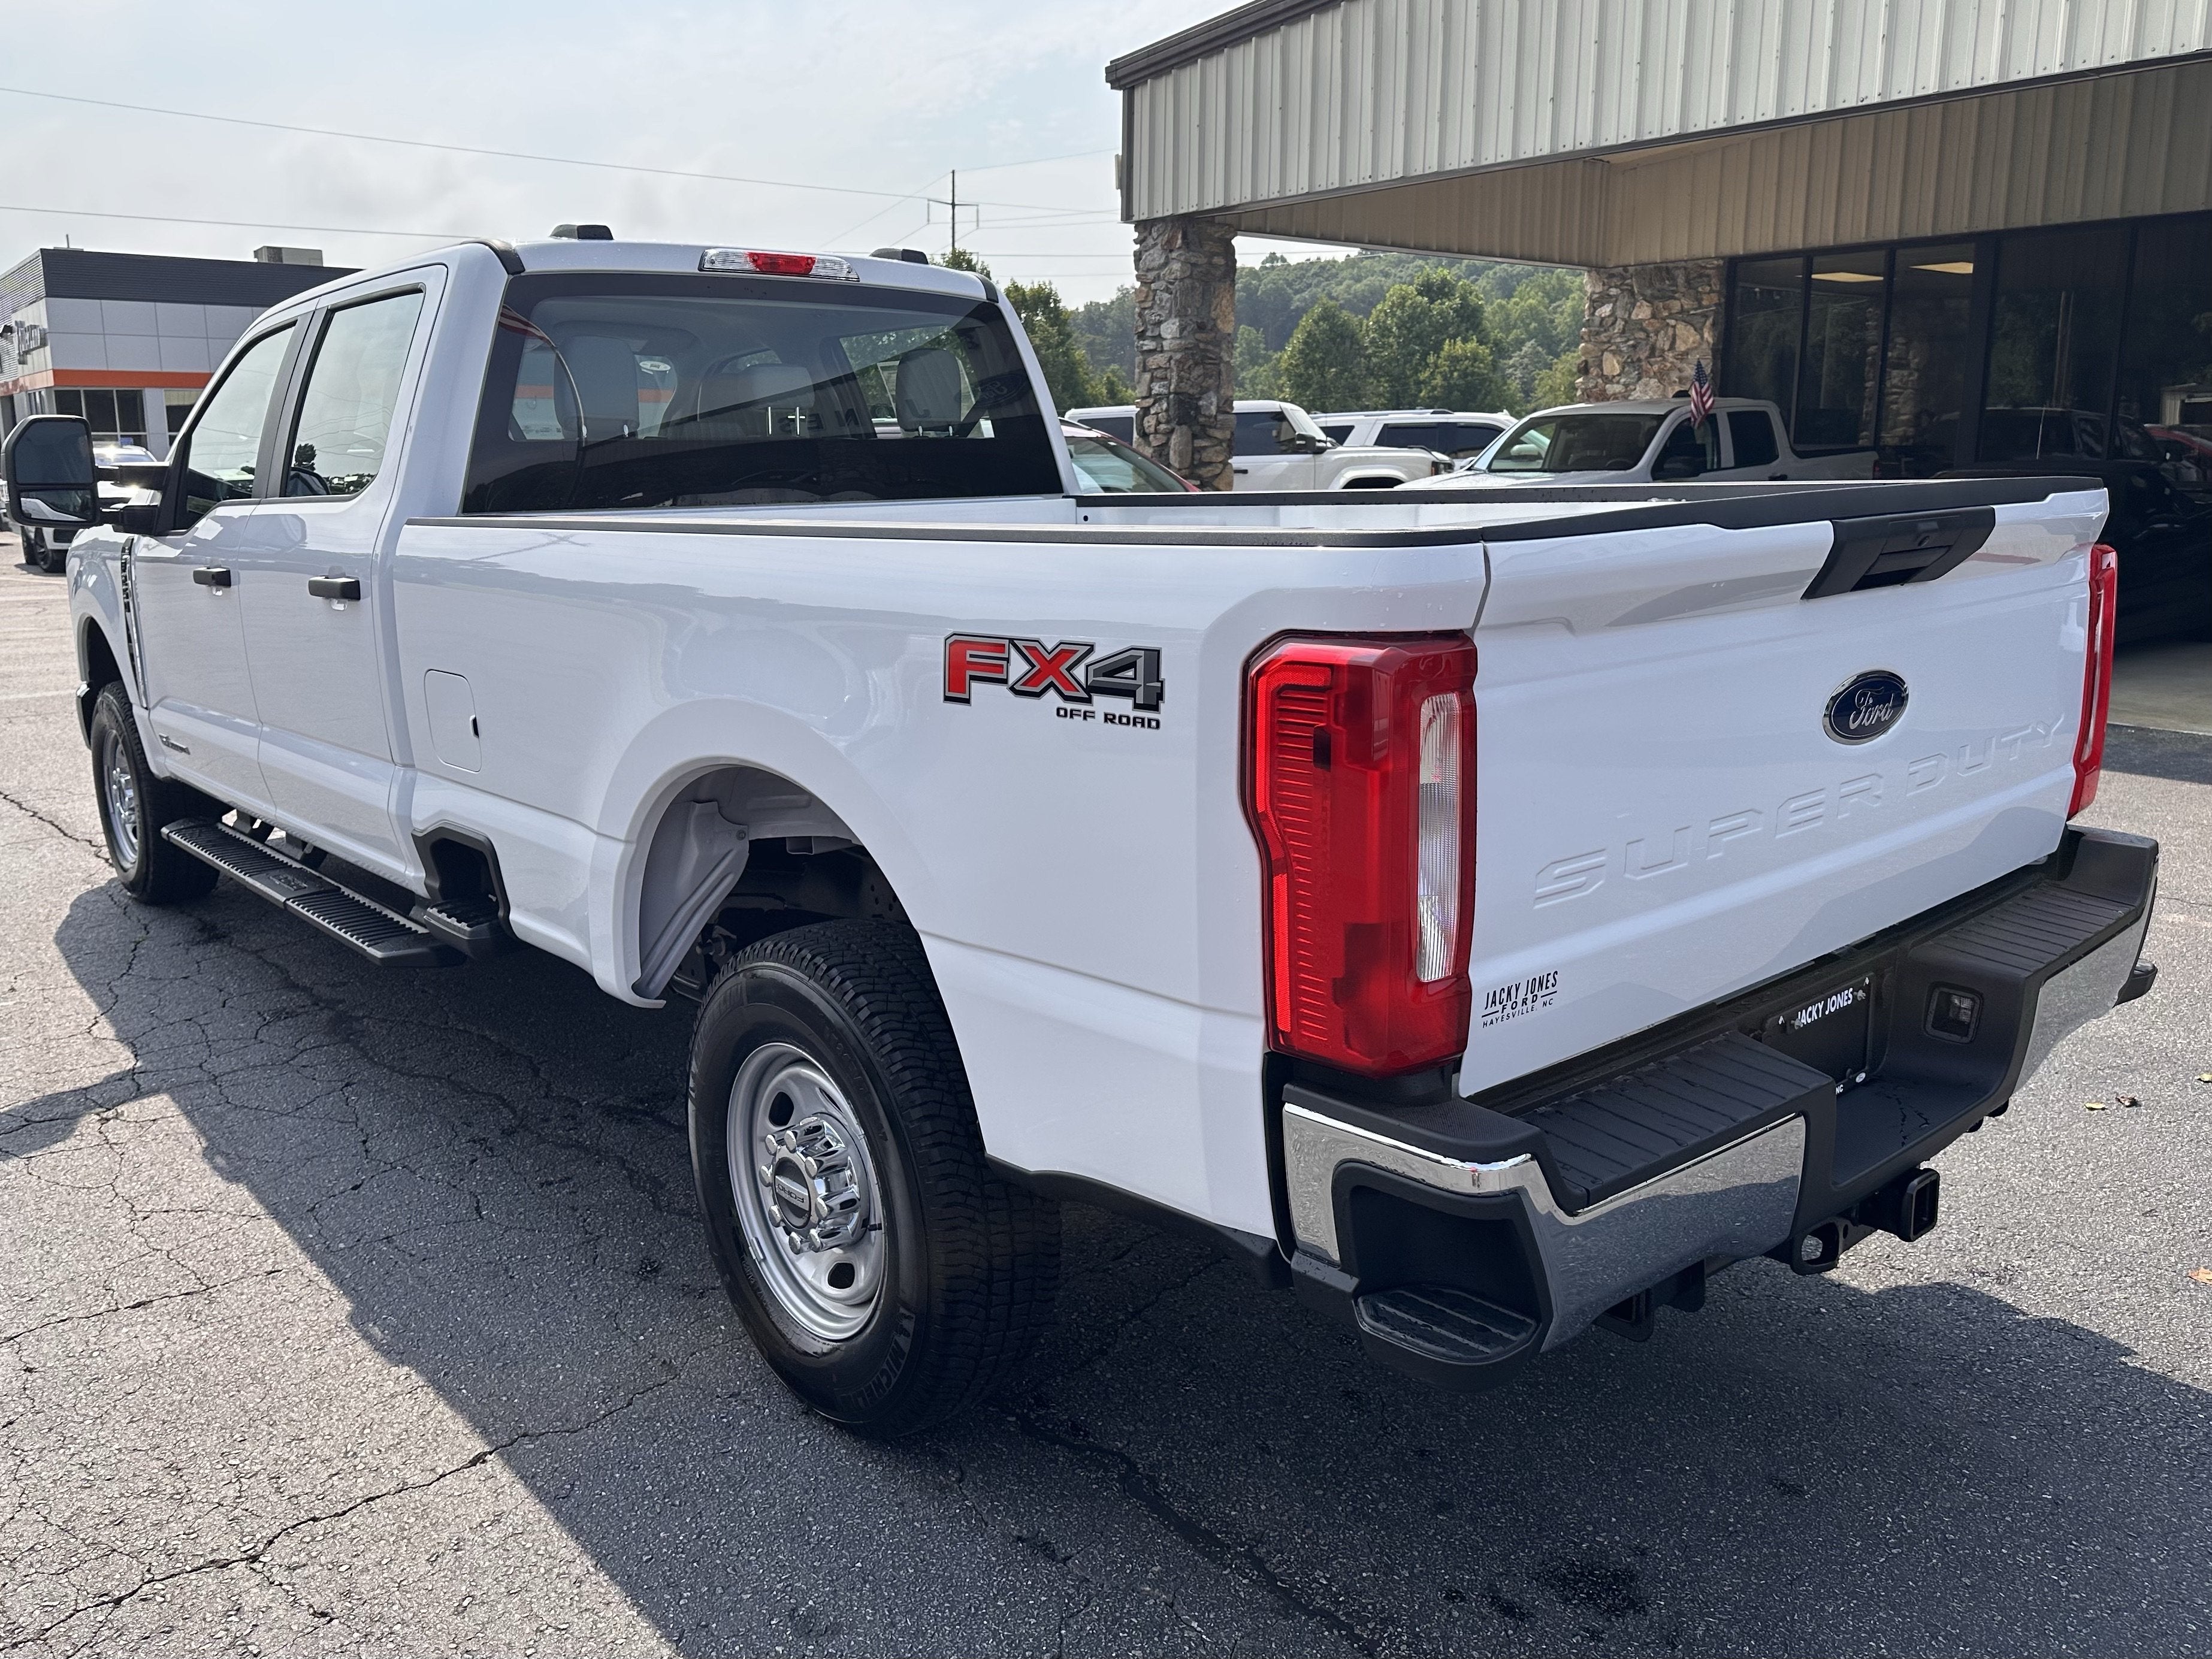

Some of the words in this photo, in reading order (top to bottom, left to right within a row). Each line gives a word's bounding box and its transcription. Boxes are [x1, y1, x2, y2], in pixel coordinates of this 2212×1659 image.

[943, 631, 1165, 714] FX4
[1056, 706, 1095, 722] OFF
[1104, 712, 1161, 730] ROAD
[1849, 686, 1894, 730] Ford
[1533, 772, 1885, 909] SUPER
[1906, 714, 2066, 797] DUTY
[1485, 983, 1521, 1010] JACKY
[1524, 971, 1558, 997] JONES
[1501, 994, 1538, 1014] FORD
[1542, 998, 1554, 1008] NC
[1825, 988, 1853, 1015] JONES
[778, 1183, 805, 1204] FORD
